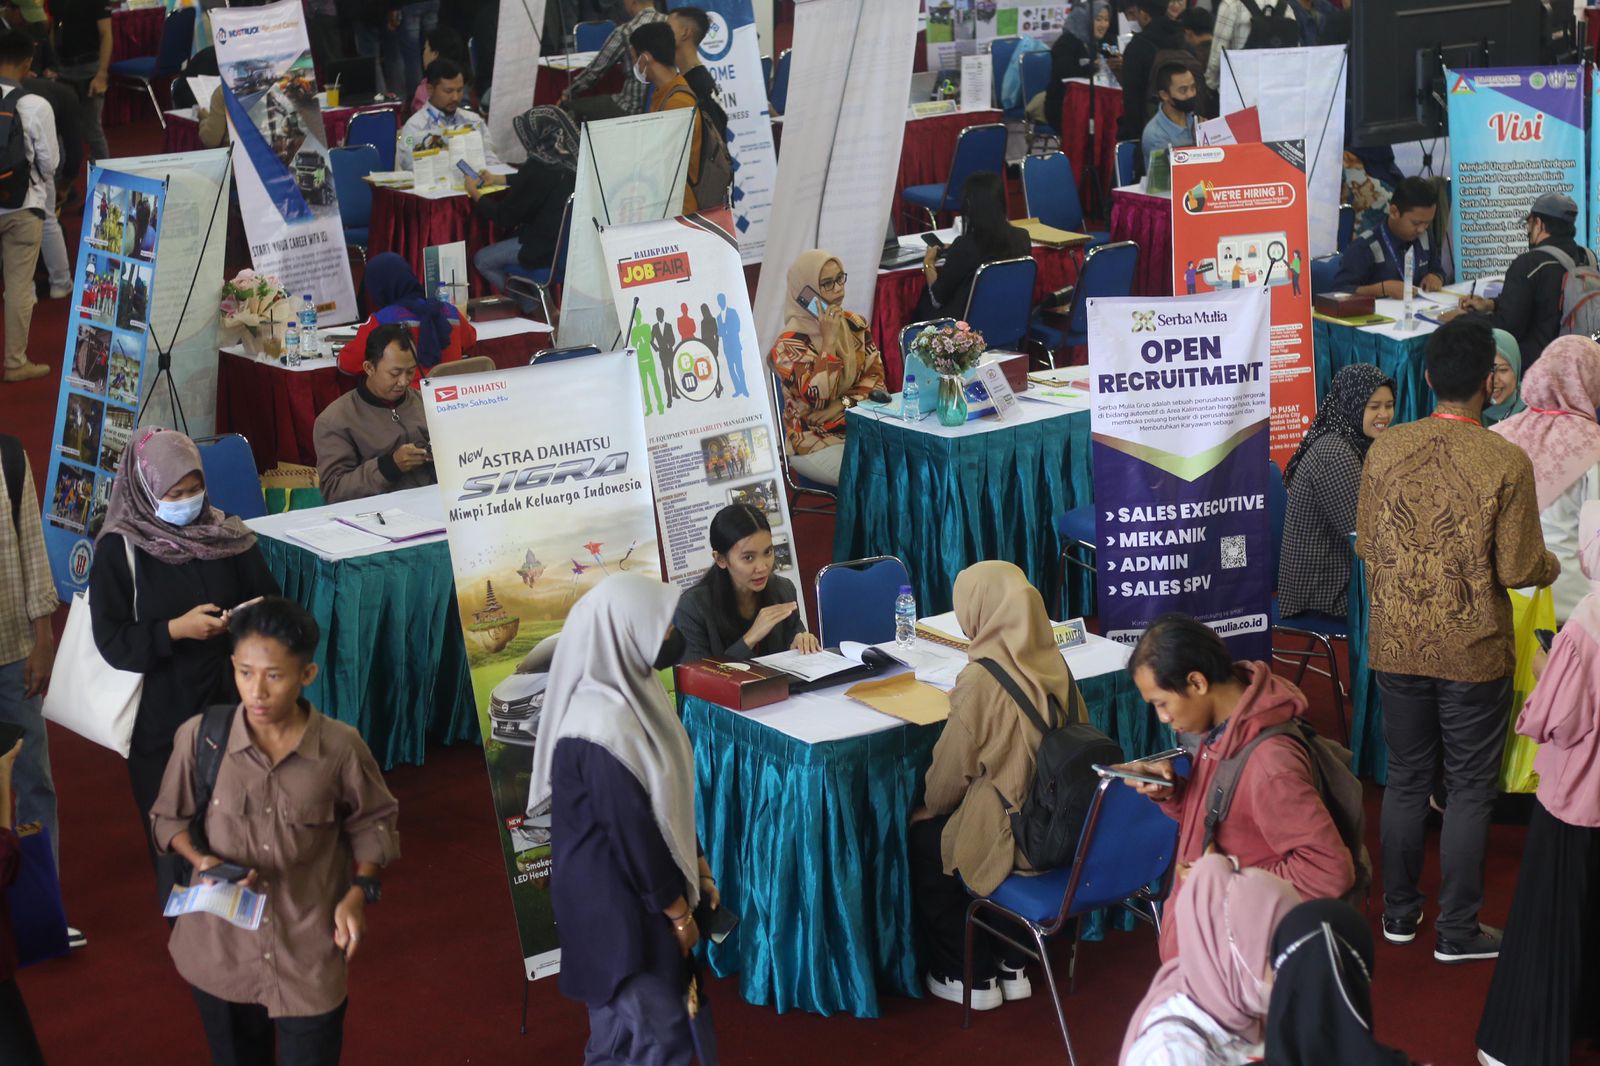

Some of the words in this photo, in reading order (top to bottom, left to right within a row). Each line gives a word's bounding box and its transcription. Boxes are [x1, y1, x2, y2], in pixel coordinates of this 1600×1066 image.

[1489, 113, 1544, 142] Visi
[1541, 160, 1576, 170] Terdepan
[1212, 190, 1241, 202] WE'RE
[1244, 188, 1276, 199] HIRING
[1460, 187, 1490, 196] Catering
[1460, 200, 1480, 209] Serta
[1480, 198, 1528, 208] Management
[634, 244, 680, 259] BALIKPAPAN
[1157, 313, 1192, 327] Serba
[1194, 310, 1228, 324] Mulia
[1141, 336, 1222, 364] OPEN
[1098, 362, 1263, 394] RECRUITMENT
[461, 381, 507, 397] DAIHATSU
[1151, 400, 1171, 408] adalah
[1172, 399, 1193, 407] sebuah
[1278, 404, 1299, 414] PUSAT
[1105, 410, 1129, 420] bidang
[1166, 406, 1181, 414] Area
[1181, 404, 1216, 413] Kalimantan
[722, 414, 763, 427] MANAGEMENT
[1112, 418, 1143, 426] membuka
[1139, 423, 1179, 432] Membutuhkan
[1180, 421, 1211, 430] Karyawan
[458, 447, 484, 468] New
[482, 448, 535, 470] ASTRA
[537, 436, 612, 460] DAIHATSU
[458, 451, 630, 501] SIGRA
[449, 503, 484, 523] Mimpi
[487, 495, 522, 516] Indah
[526, 489, 581, 509] Keluarga
[584, 478, 642, 500] Indonesia
[1118, 504, 1177, 523] SALES
[1180, 494, 1265, 519] EXECUTIVE
[1119, 526, 1207, 548] MEKANIK
[1120, 553, 1189, 573] ADMIN
[1121, 580, 1180, 597] SALES
[1183, 574, 1212, 593] SPV
[1212, 617, 1263, 634] mulia.co.id
[1065, 629, 1083, 641] AUTO
[508, 818, 522, 827] NEW
[513, 874, 528, 885] LED
[529, 870, 549, 881] Head
